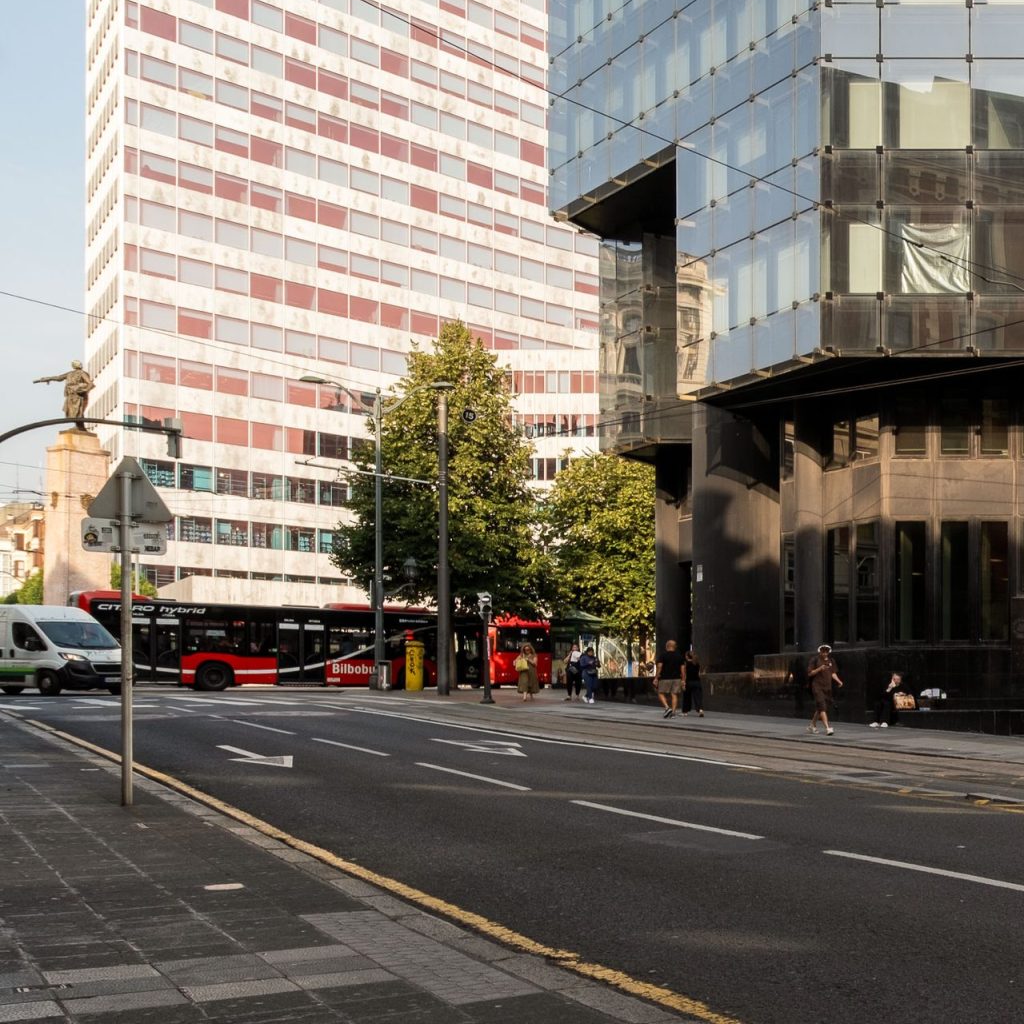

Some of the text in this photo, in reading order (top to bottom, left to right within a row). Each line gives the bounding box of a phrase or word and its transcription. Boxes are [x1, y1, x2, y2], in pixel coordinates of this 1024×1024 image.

[97, 603, 155, 612] CITRO
[159, 605, 207, 615] hybrid
[332, 663, 377, 675] Bilbobu
